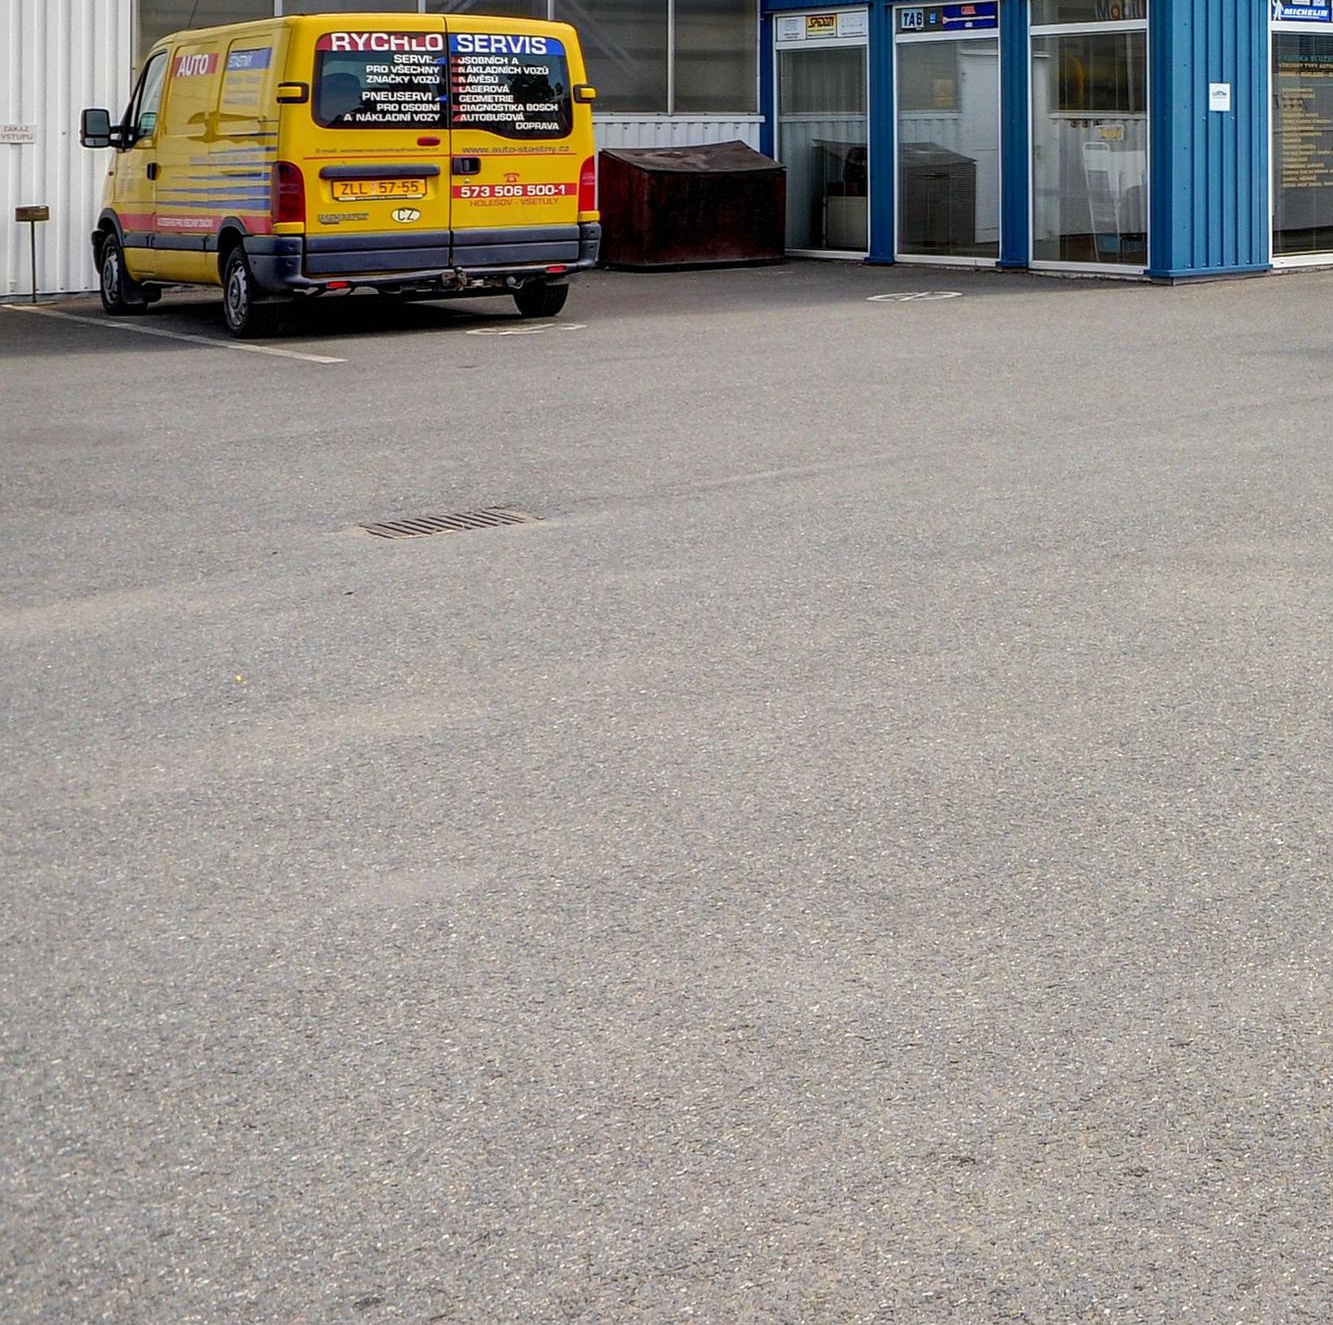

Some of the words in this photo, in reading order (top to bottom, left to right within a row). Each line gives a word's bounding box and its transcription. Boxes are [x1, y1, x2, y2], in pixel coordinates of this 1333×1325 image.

[1284, 8, 1328, 17] MICHELIN
[331, 32, 443, 52] RYCHLO
[457, 34, 547, 55] SERVIS
[177, 54, 209, 77] AUTO
[511, 57, 519, 65] A
[366, 65, 389, 73] PRO
[366, 74, 410, 84] ZNAČKY
[362, 91, 439, 102] PNEUSERVI
[459, 94, 514, 103] GEOMETRIE
[376, 103, 399, 112] PRO
[460, 103, 525, 112] DIAGNOSTIKA
[526, 103, 559, 112] BOSCH
[343, 113, 353, 121] A
[412, 113, 441, 122] VOZY
[460, 112, 525, 122] AUTOBUSOVÁ
[515, 122, 560, 131] DOPRAVA
[340, 182, 368, 195] ZLL
[378, 180, 419, 194] 57-55
[461, 186, 490, 197] 573
[494, 185, 522, 196] 506
[527, 184, 566, 196] 500-1
[397, 209, 415, 221] CZ
